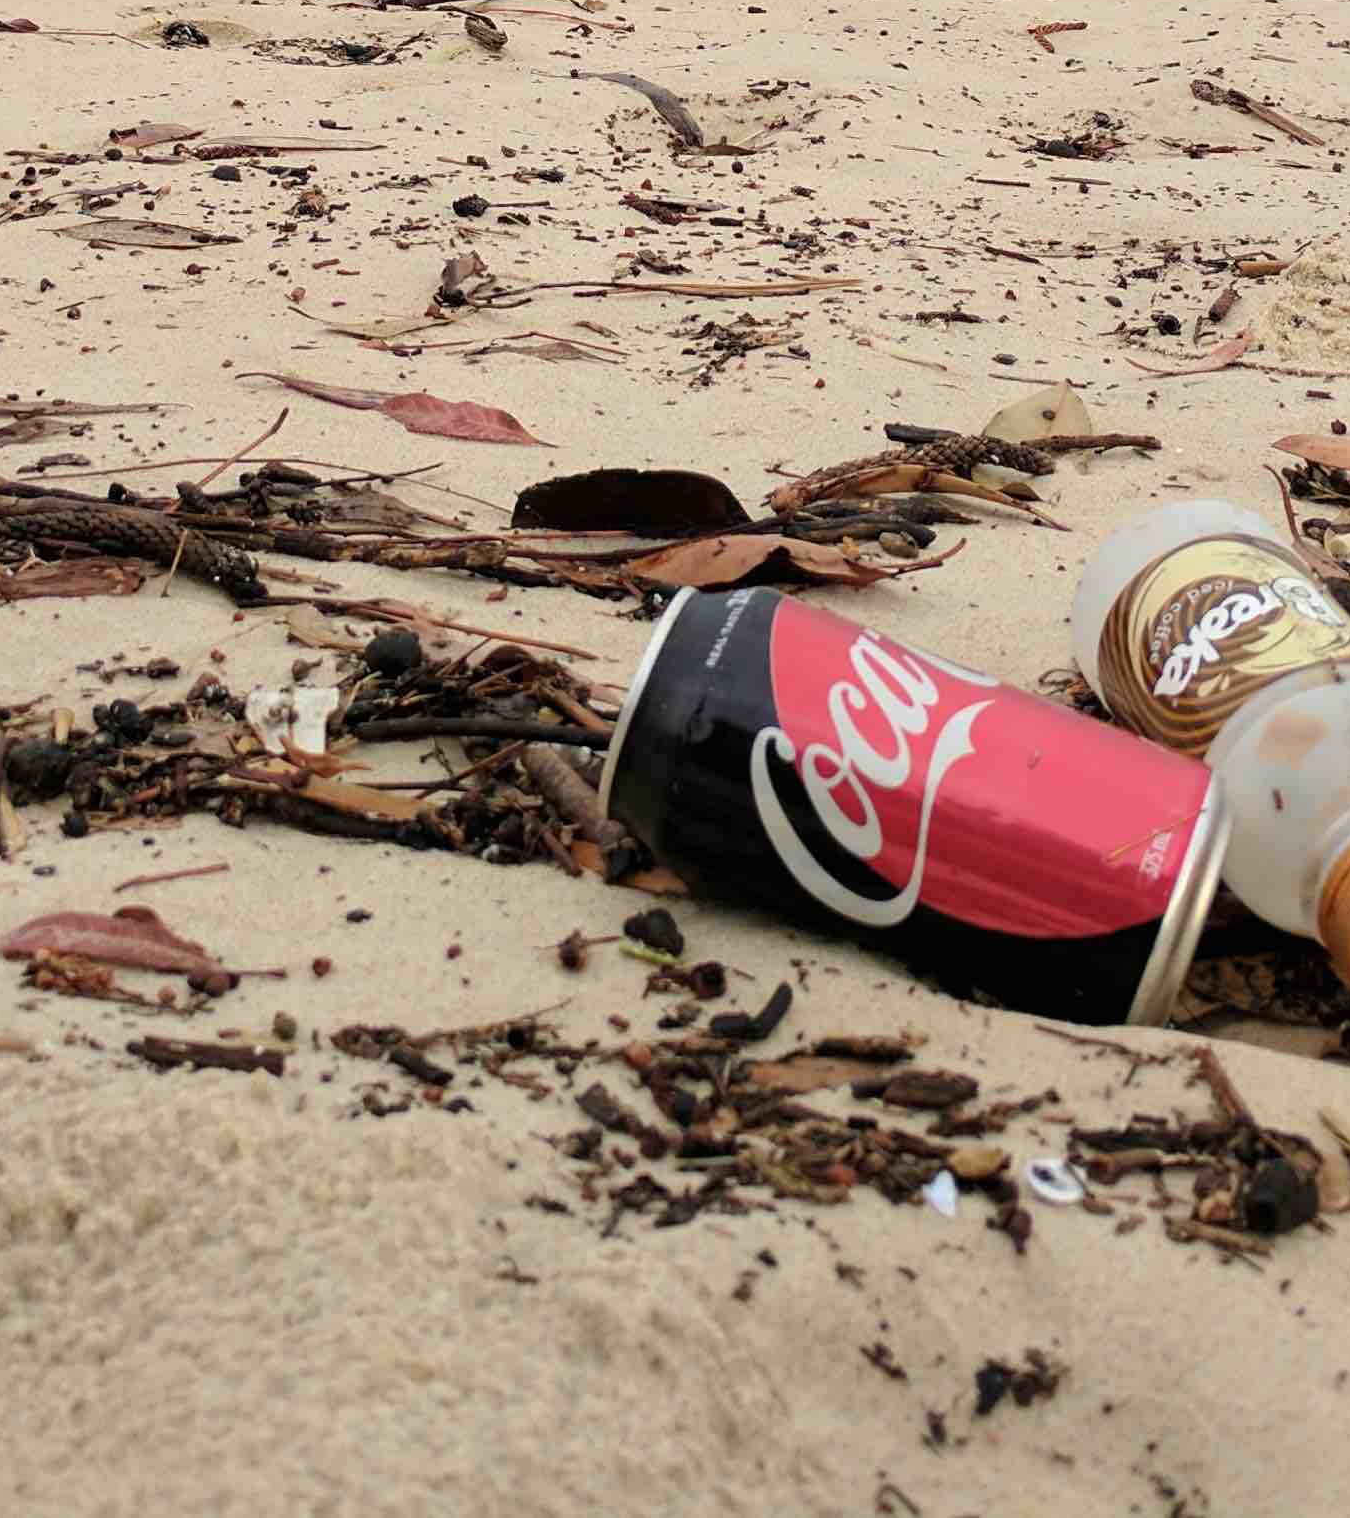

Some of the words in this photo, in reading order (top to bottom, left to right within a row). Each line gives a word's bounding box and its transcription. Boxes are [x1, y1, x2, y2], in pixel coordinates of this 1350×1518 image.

[1149, 602, 1182, 666] coffee
[1153, 576, 1346, 697] Breaka
[1186, 579, 1234, 604] iced
[750, 631, 996, 929] Coca
